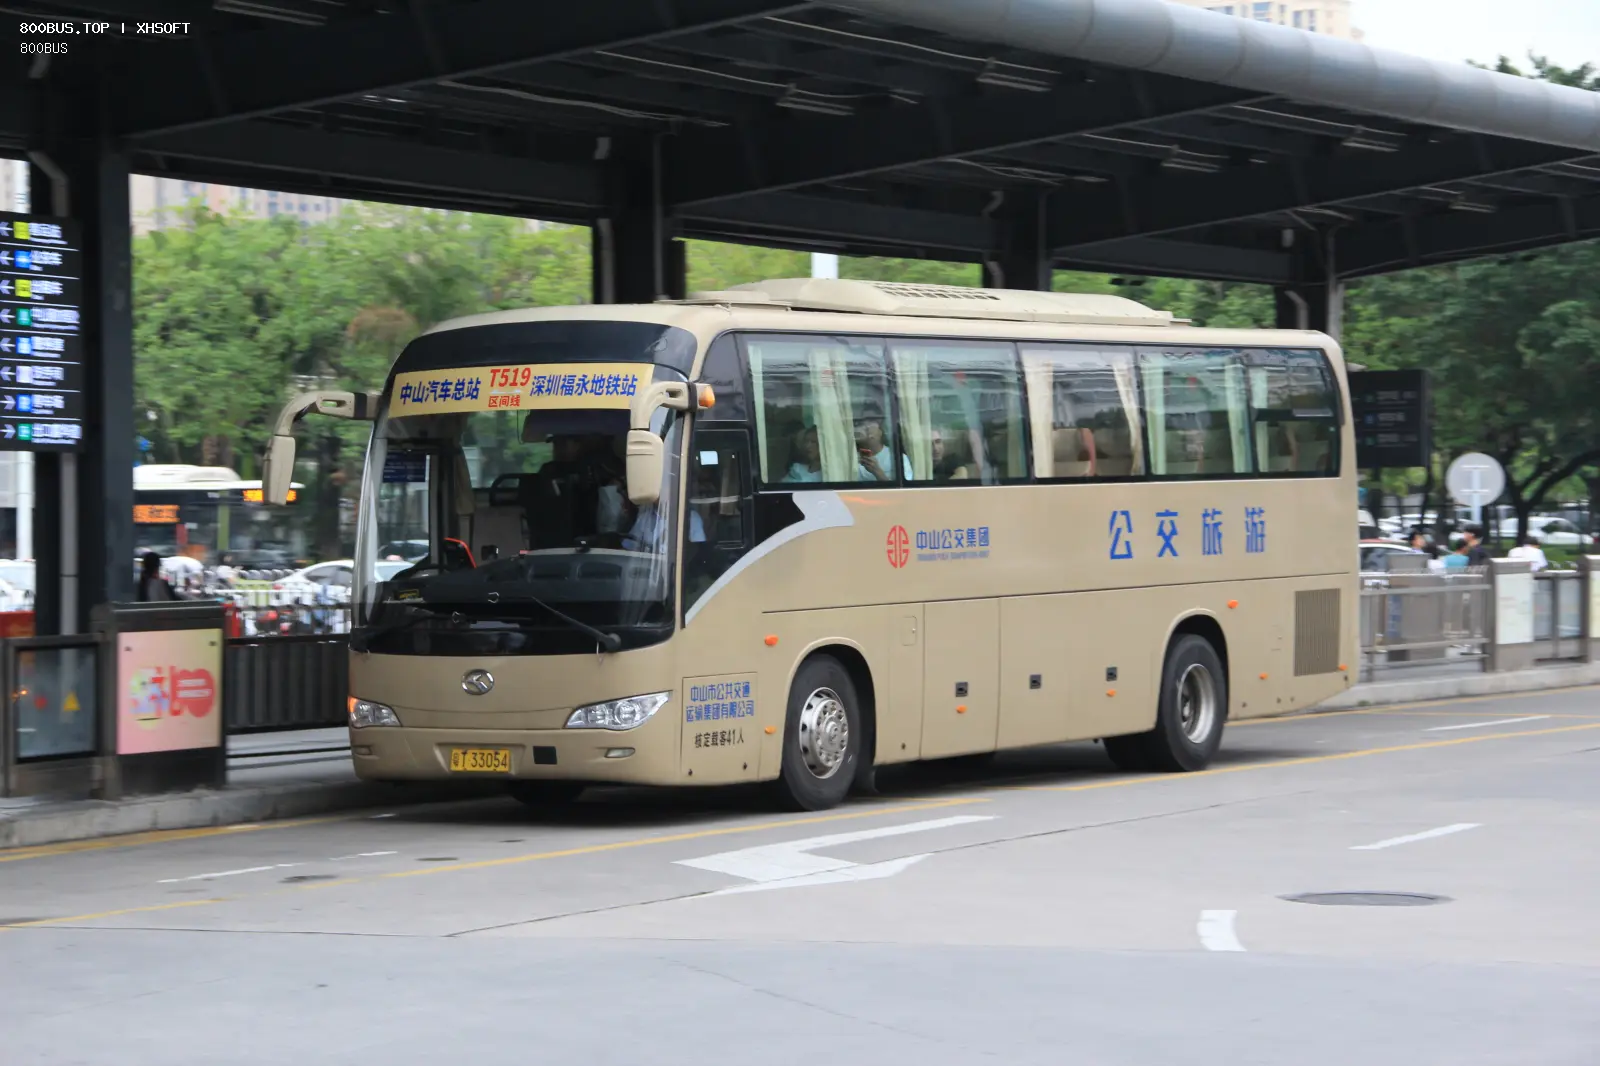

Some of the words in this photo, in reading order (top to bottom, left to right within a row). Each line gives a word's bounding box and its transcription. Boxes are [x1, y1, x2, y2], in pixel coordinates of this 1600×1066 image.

[490, 367, 532, 388] T519
[529, 374, 638, 398] 深圳福永地铁站
[399, 376, 482, 405] 中山汽车总站
[488, 394, 521, 408] 区间线
[916, 526, 990, 550] 中山公交集团
[1109, 506, 1266, 560] 公交旅游
[690, 681, 751, 702] 中山市公共交通
[685, 699, 755, 723] 运输集团有限公司
